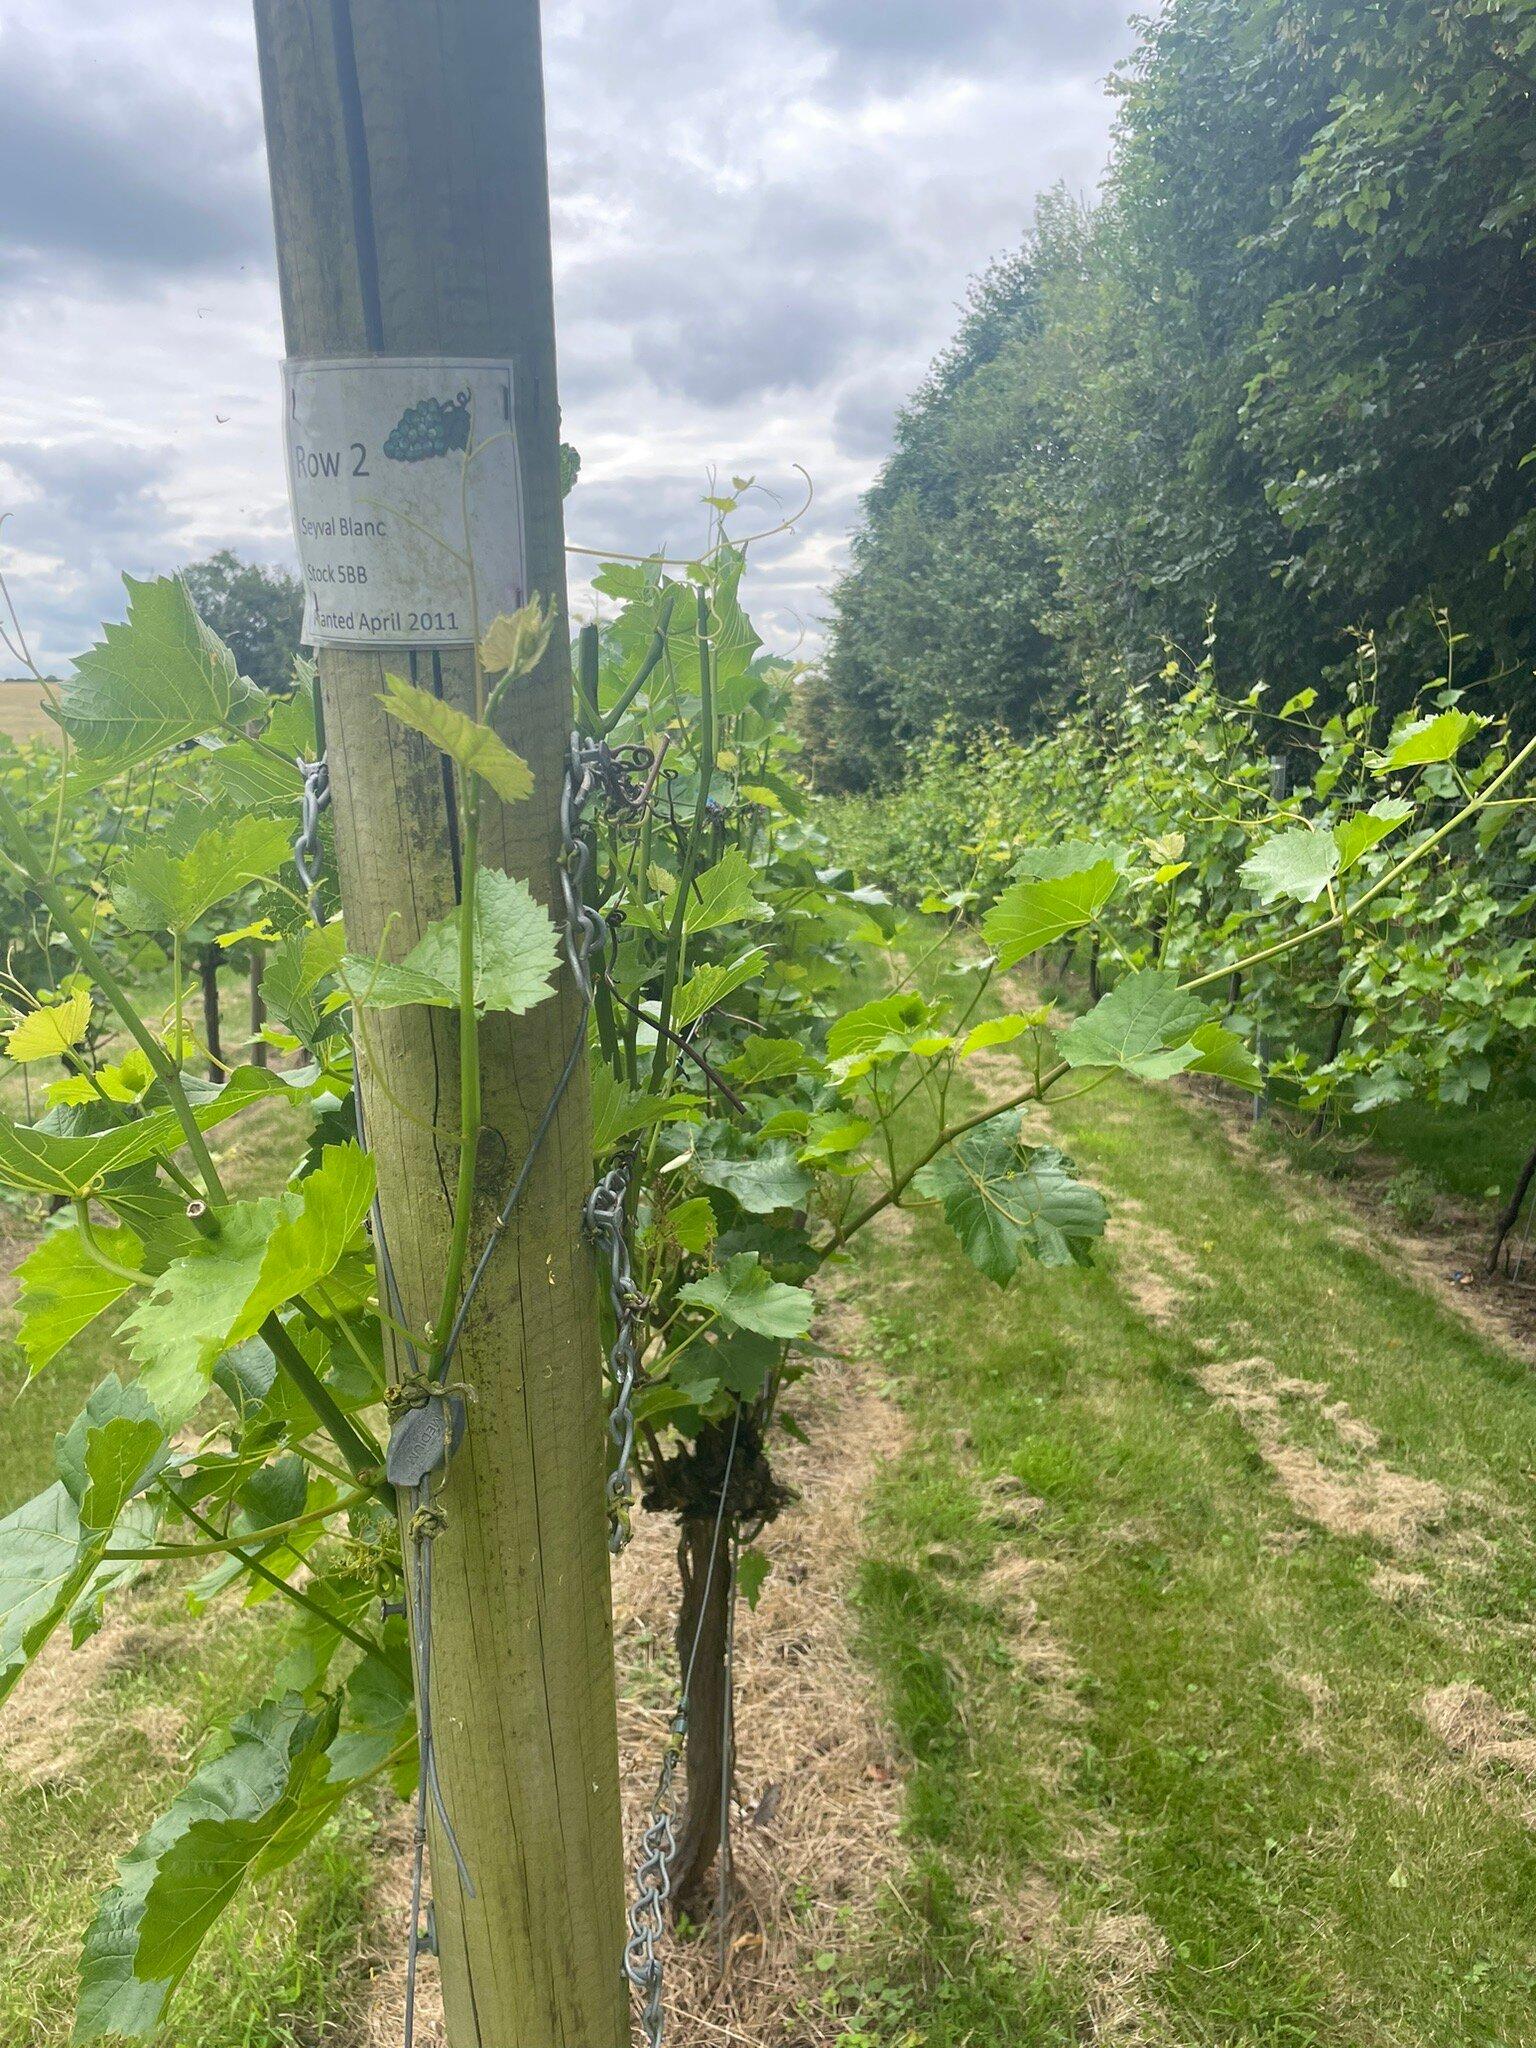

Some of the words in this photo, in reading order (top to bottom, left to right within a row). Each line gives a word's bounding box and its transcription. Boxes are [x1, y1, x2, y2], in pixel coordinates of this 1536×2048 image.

[295, 445, 340, 478] Row
[350, 442, 370, 477] 2
[300, 516, 336, 540] Seyval
[339, 516, 387, 537] Blanc
[306, 563, 336, 584] Stock
[338, 565, 368, 585] 5BB
[313, 611, 355, 630] anted
[358, 612, 402, 635] April
[408, 611, 459, 631] 2011
[406, 1415, 443, 1465] MEDIUM
